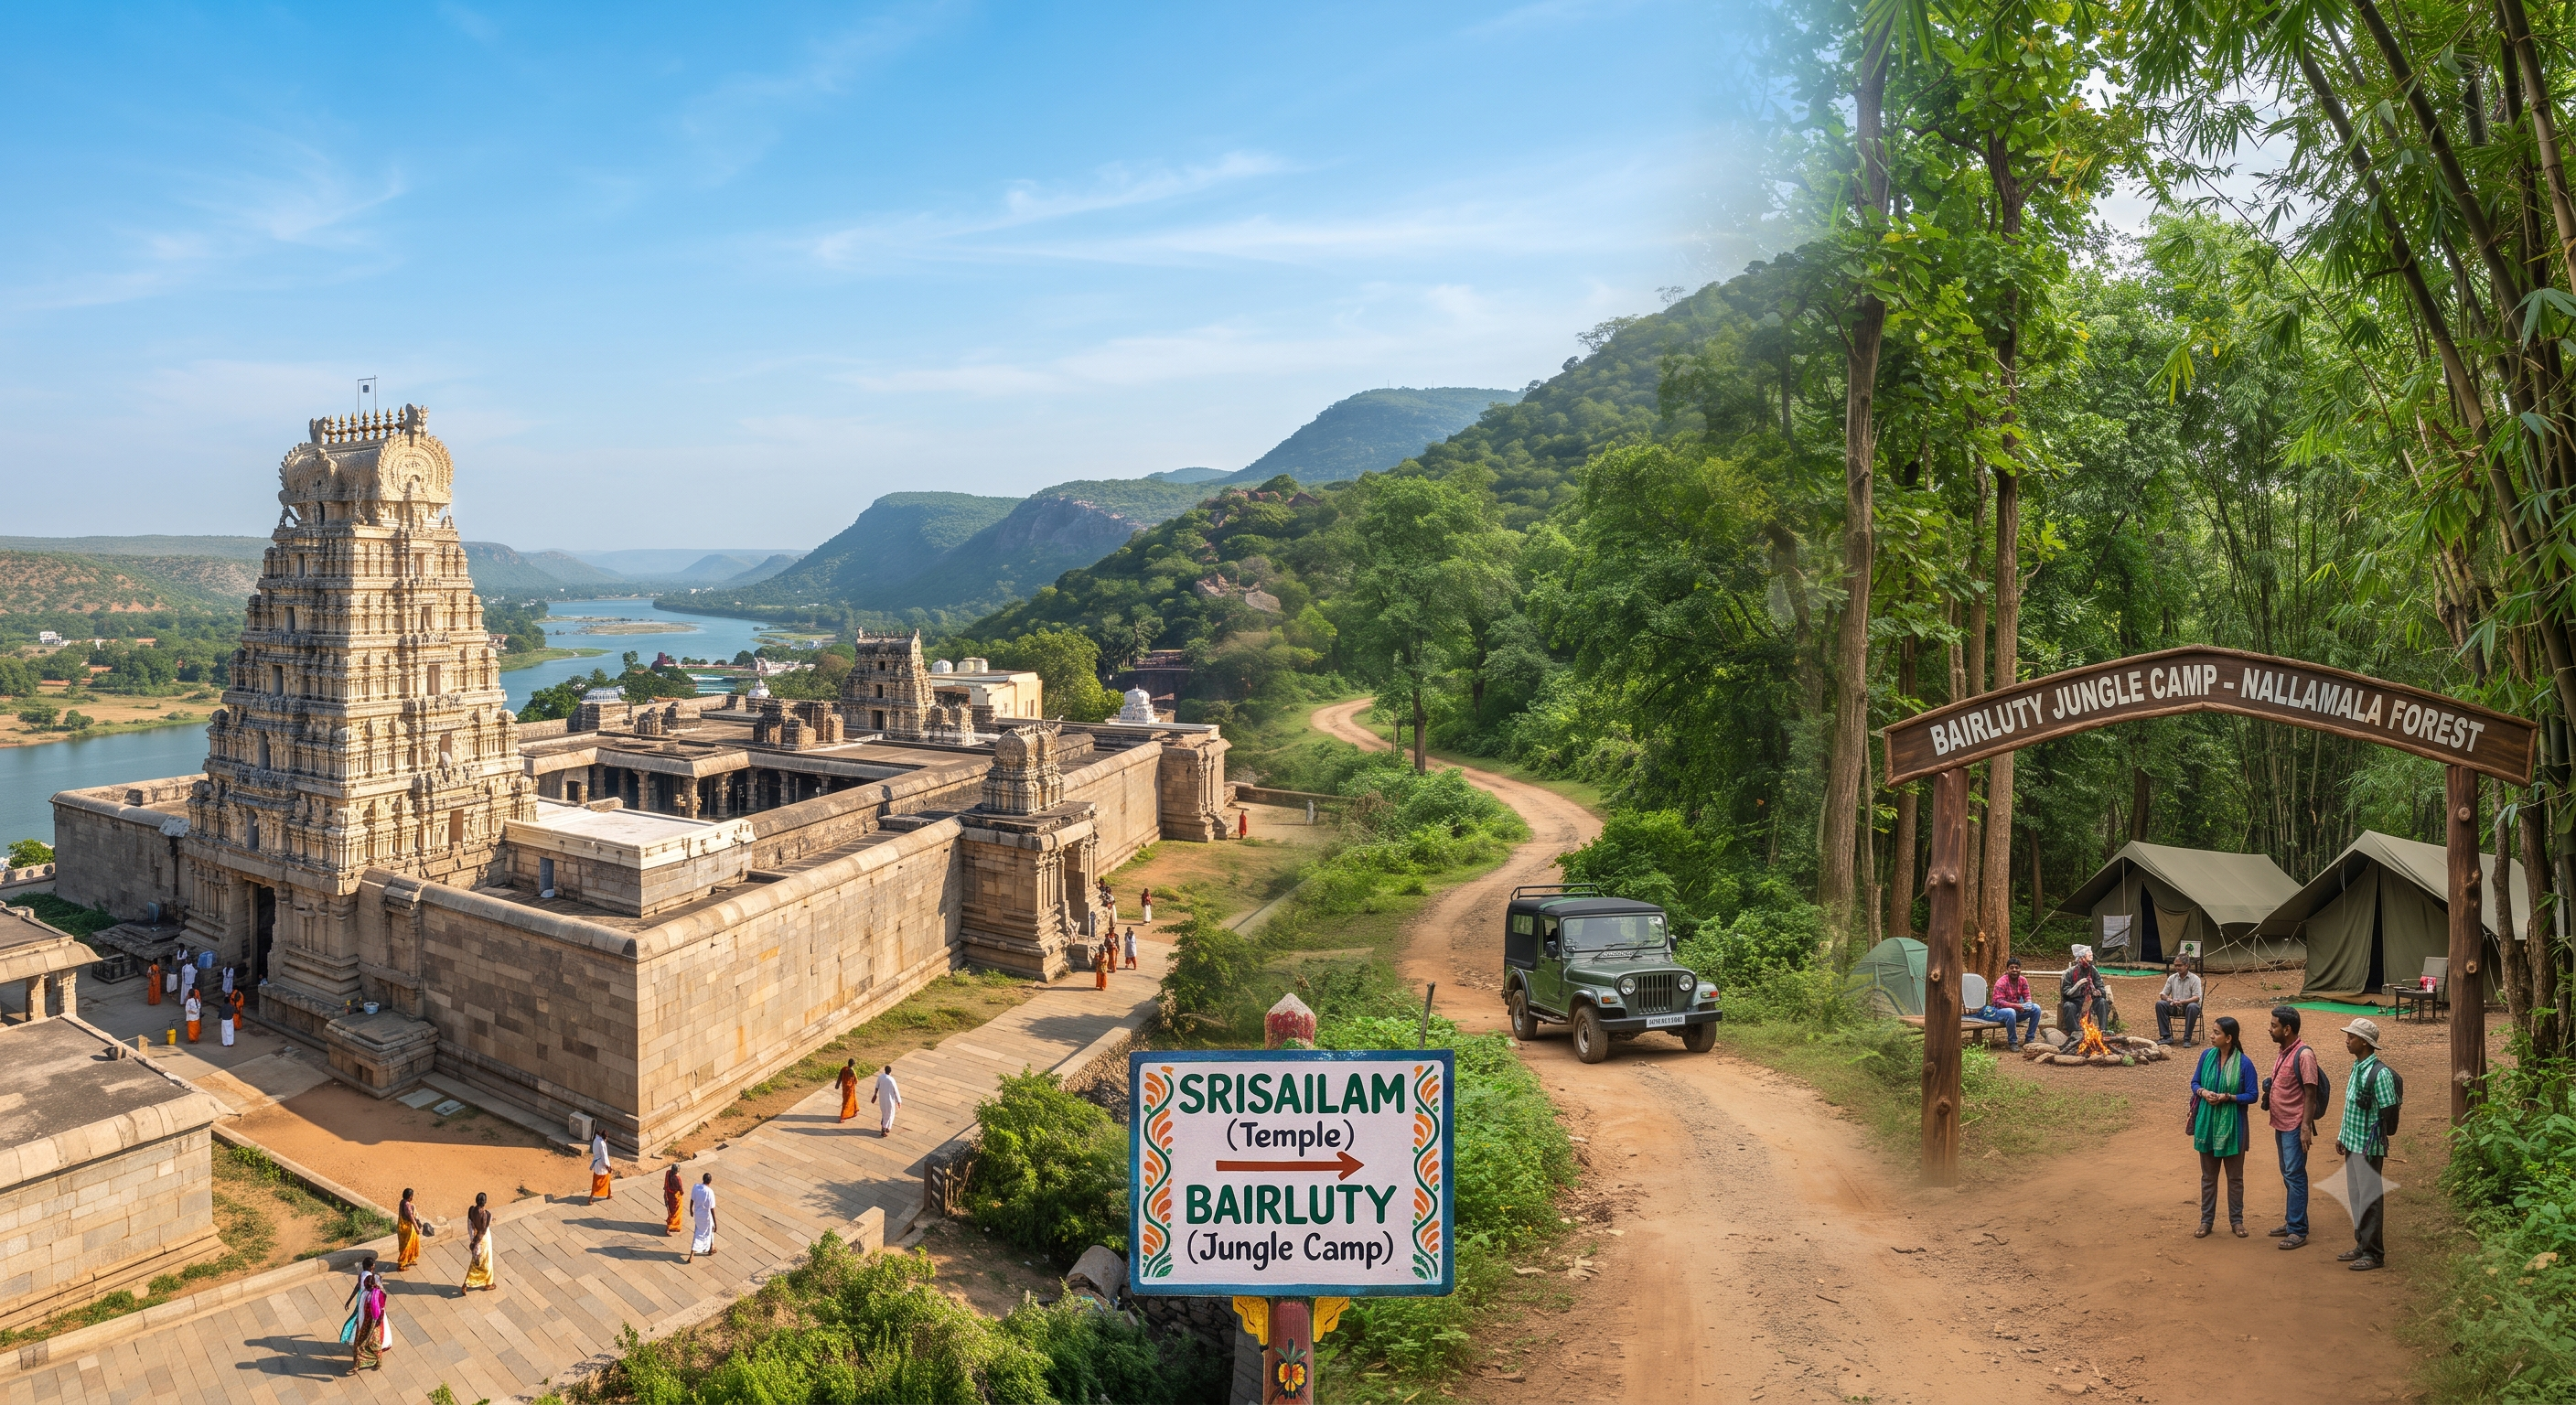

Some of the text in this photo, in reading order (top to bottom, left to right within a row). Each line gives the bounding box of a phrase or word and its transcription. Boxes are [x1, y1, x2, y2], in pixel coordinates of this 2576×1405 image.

[1929, 693, 2043, 756] BAIRLUTY
[2052, 670, 2145, 720] JUNGLE
[2150, 664, 2217, 700] CAMP
[2240, 667, 2383, 726] NALLAMALA
[2388, 699, 2485, 752] FOREST
[1178, 1072, 1406, 1115] SRISAILAM
[1227, 1118, 1355, 1156] (Temple)
[1186, 1184, 1398, 1225] BAIRLUTY
[1186, 1229, 1395, 1271] (Jungle Camp)
